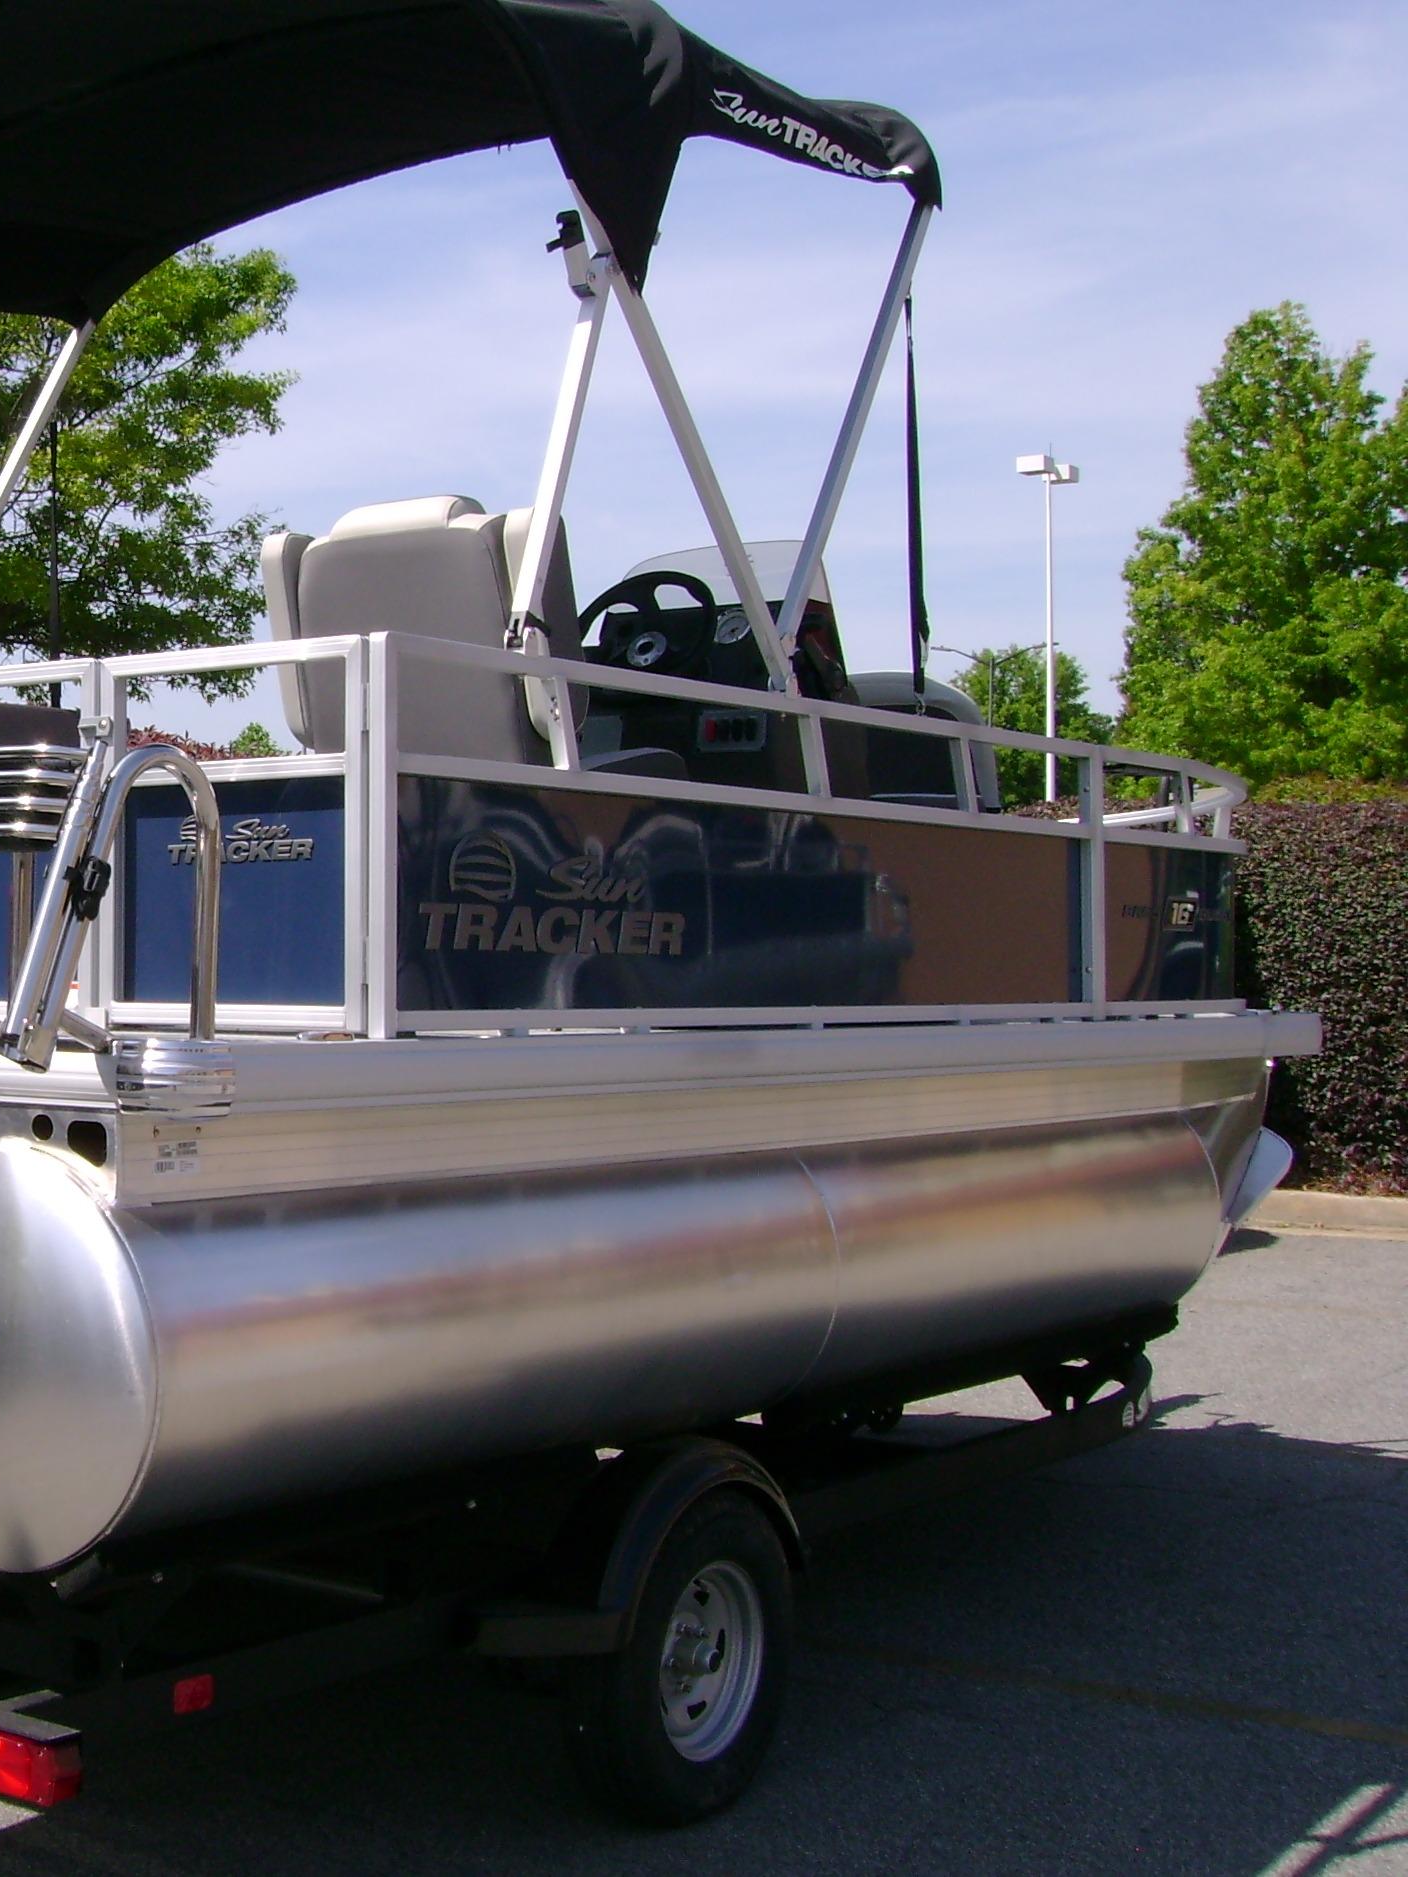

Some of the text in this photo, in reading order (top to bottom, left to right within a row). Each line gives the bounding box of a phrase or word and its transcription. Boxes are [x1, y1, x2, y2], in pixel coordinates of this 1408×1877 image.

[710, 88, 782, 137] Sun
[225, 818, 290, 840] Sun
[536, 855, 644, 902] Sun
[419, 902, 686, 956] TRACKER
